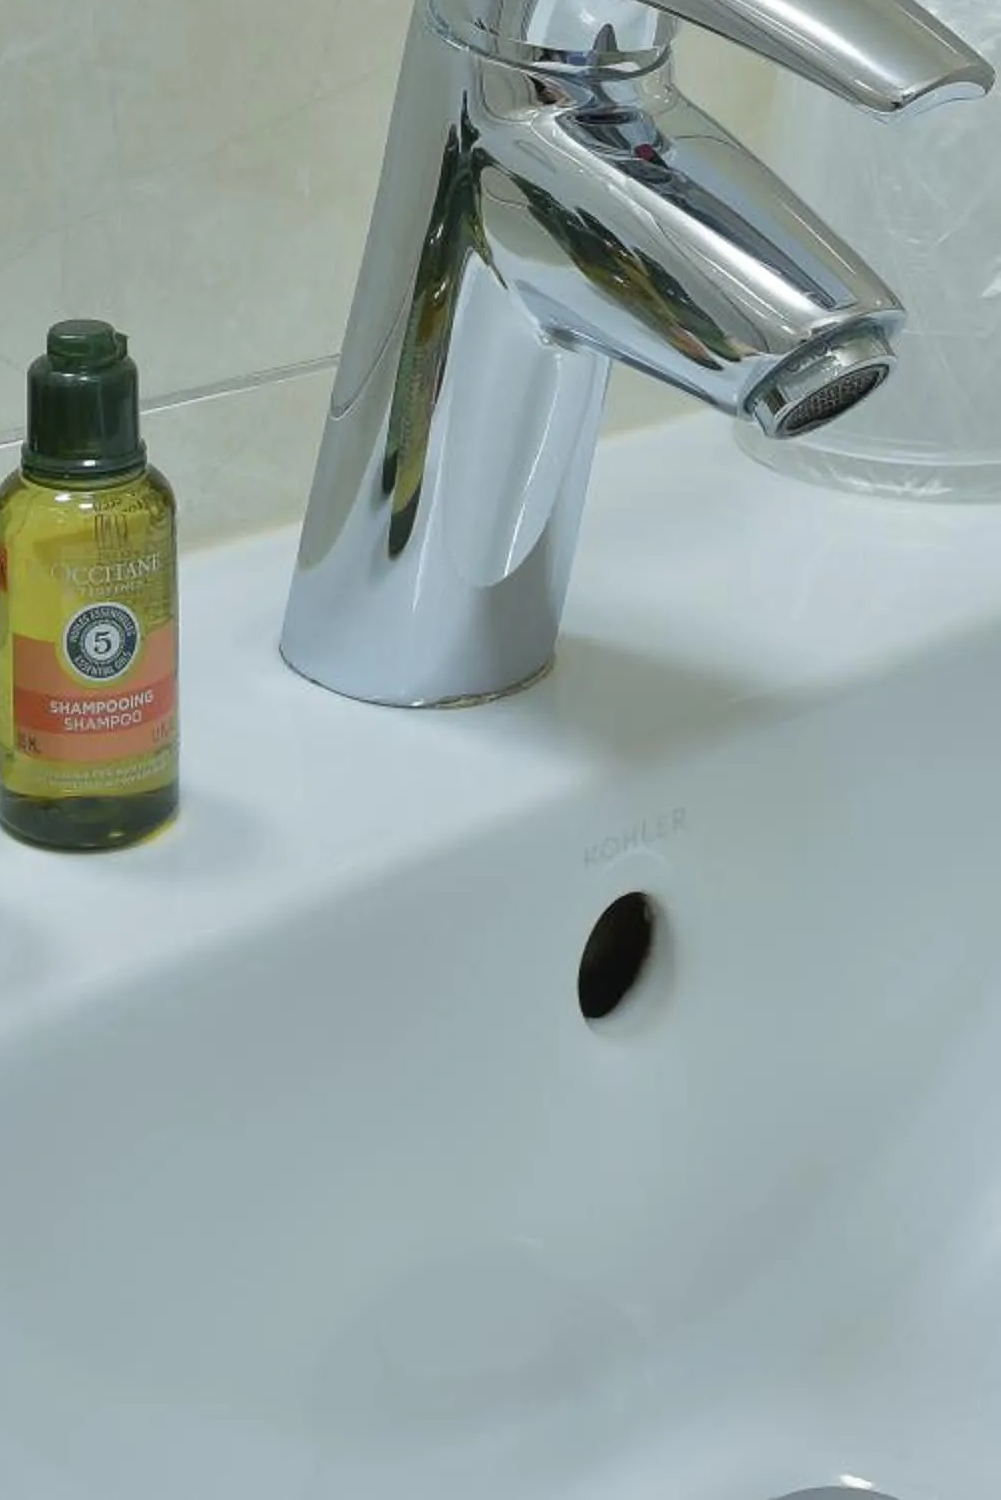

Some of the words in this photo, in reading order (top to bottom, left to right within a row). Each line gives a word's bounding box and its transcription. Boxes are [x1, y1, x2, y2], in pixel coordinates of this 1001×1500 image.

[49, 552, 160, 585] OCCITANE
[94, 631, 112, 655] 5
[50, 689, 154, 714] SHAMPOOING
[64, 710, 142, 731] SHAMPOO
[583, 805, 687, 870] KOHLER
